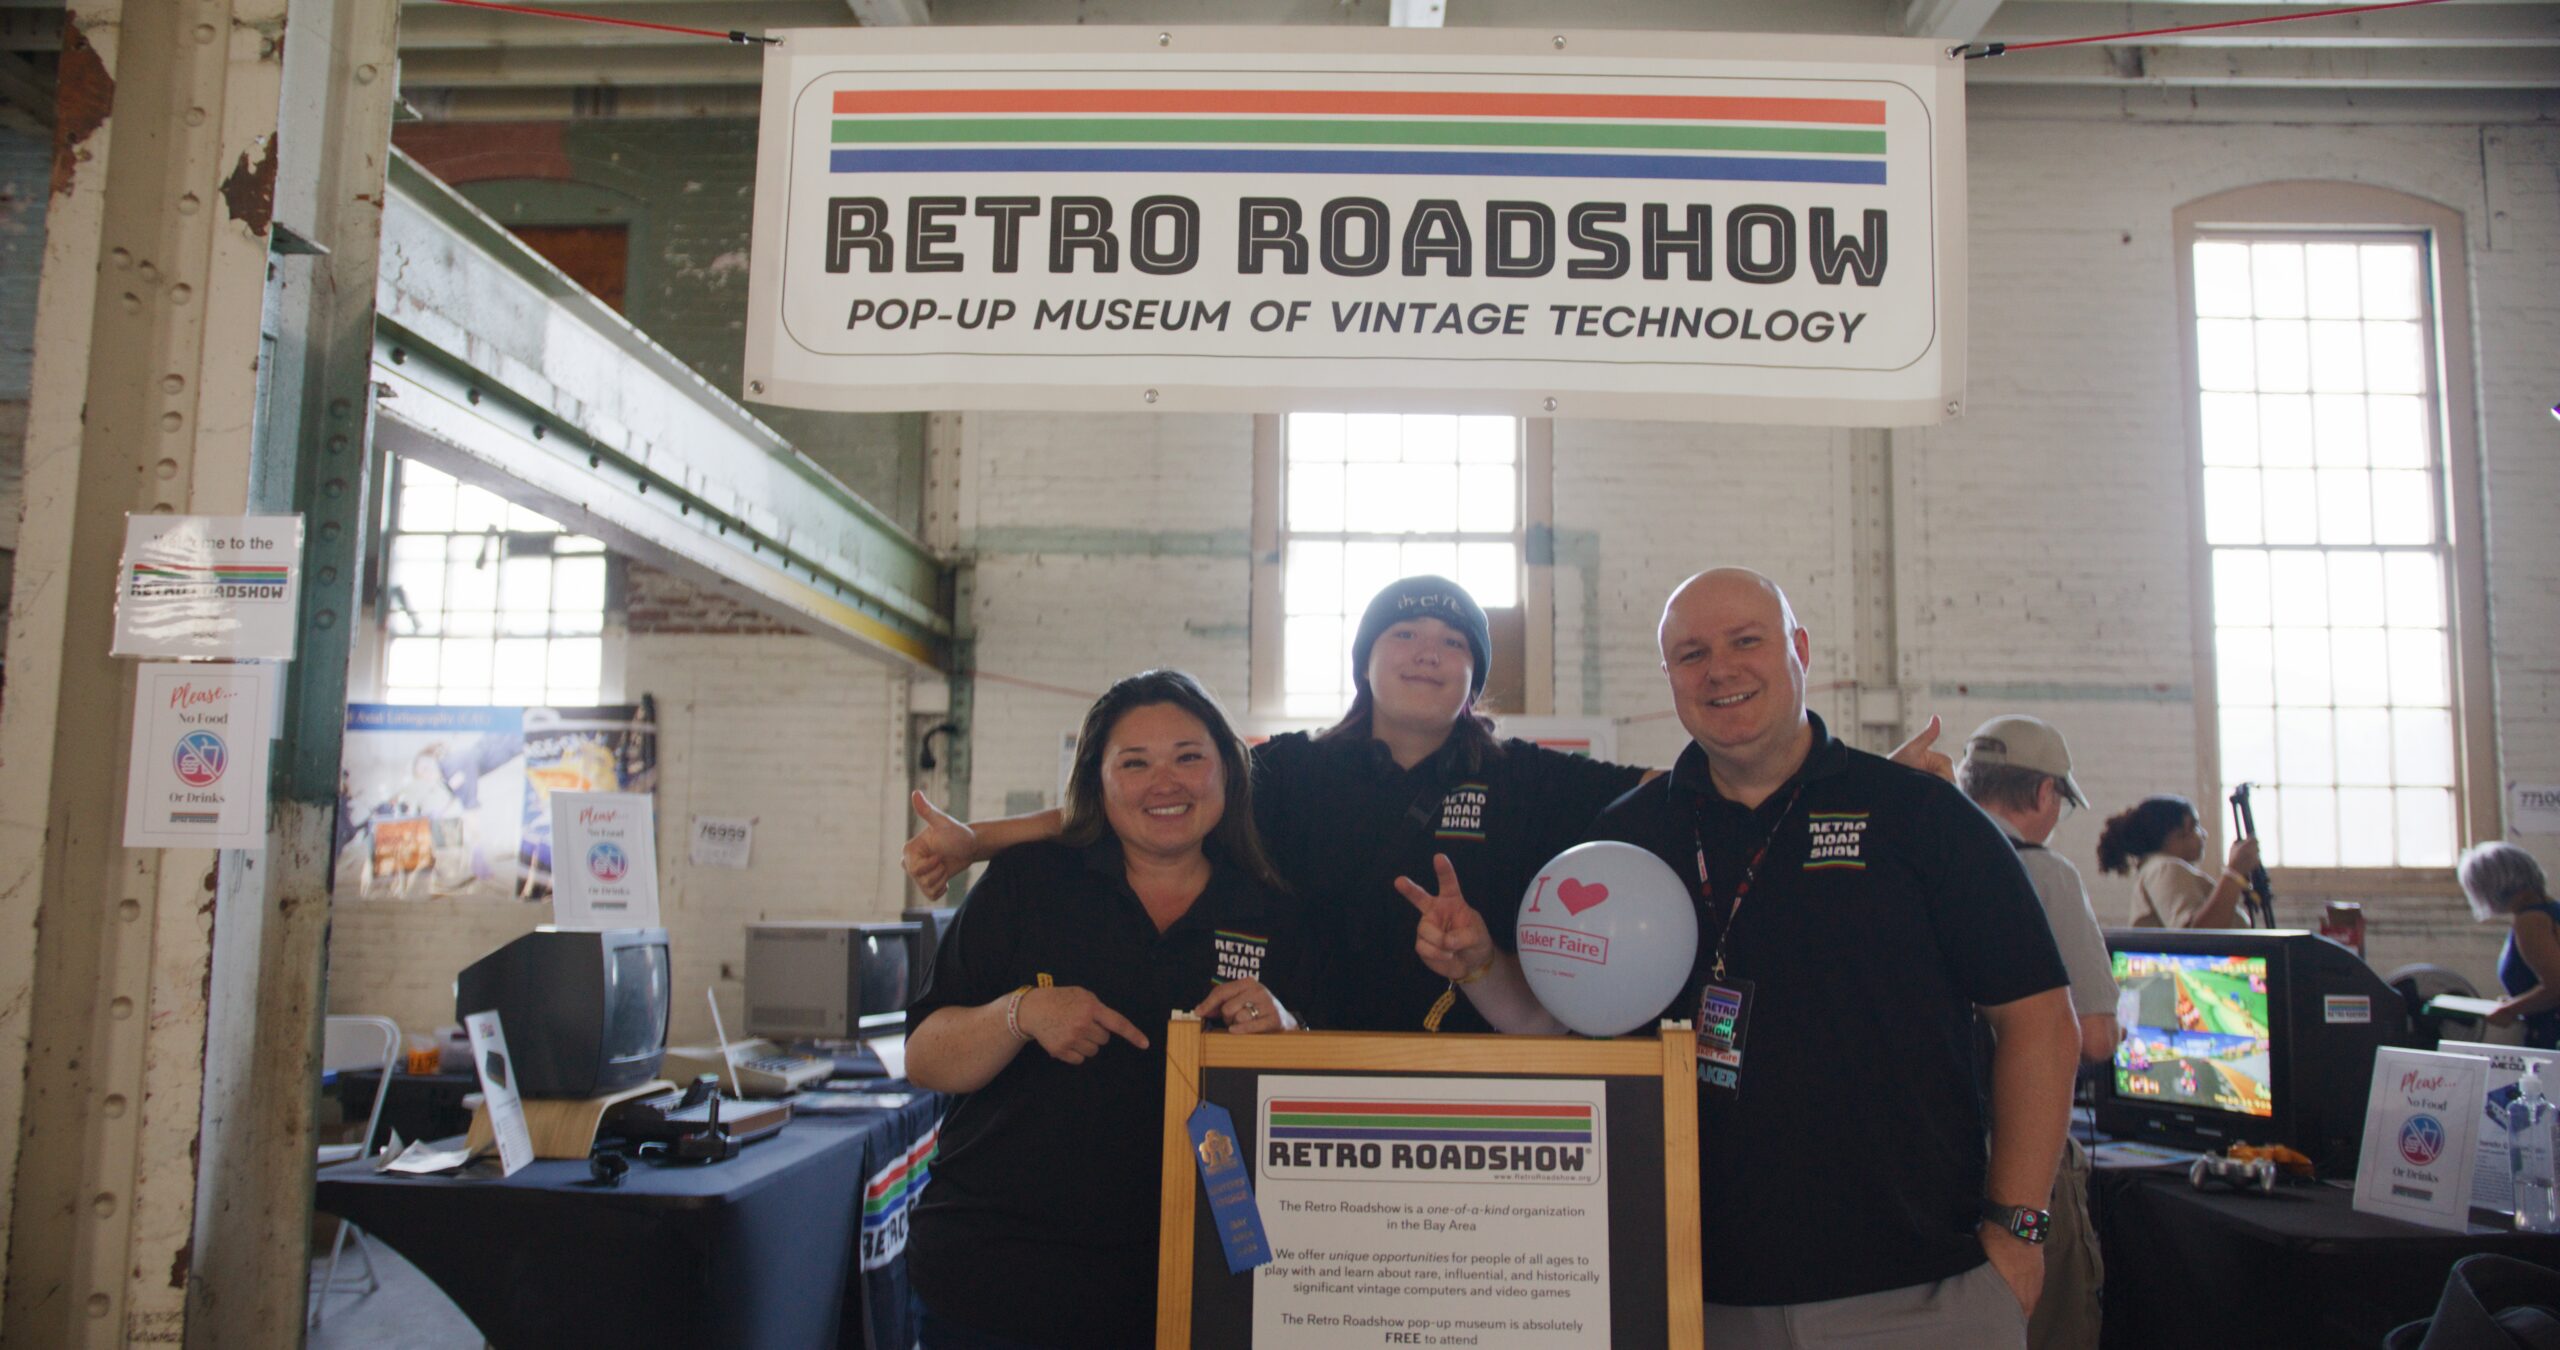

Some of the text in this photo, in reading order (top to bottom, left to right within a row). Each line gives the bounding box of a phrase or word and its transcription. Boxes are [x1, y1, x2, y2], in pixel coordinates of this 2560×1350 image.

[824, 193, 1889, 288] RETRO ROADSHOW
[847, 297, 1867, 345] POP-UP MUSEUM OF VINTAGE TECHNOLOGY
[230, 537, 245, 549] to
[250, 536, 273, 549] the
[198, 712, 229, 725] Food
[187, 792, 226, 804] Drinks
[1444, 804, 1481, 816] ROAD
[1442, 816, 1481, 829] SHOW
[1809, 821, 1867, 833] RETRO
[1813, 832, 1860, 846] ROAD
[1810, 845, 1860, 859] SHOW
[1528, 876, 1551, 913] I
[1215, 939, 1266, 958] RETRO
[1559, 934, 1599, 957] Faire
[1219, 952, 1260, 969] ROAD
[1705, 1000, 1737, 1016] RETRO
[1704, 1012, 1732, 1028] ROAD
[1697, 1062, 1738, 1089] AKER
[2422, 1097, 2448, 1111] Food
[1268, 1141, 1382, 1169] RETRO
[2407, 1168, 2440, 1183] Drinks
[1280, 1200, 1585, 1218] The Retro Roadshow is a one-of-a-kind organization
[1386, 1218, 1477, 1232] in the Bay Area
[1275, 1248, 1590, 1268] We offer unique opportunities for people of all ages to
[1264, 1265, 1600, 1284] play with and learn about rare, influential, and historically
[1293, 1281, 1571, 1300] significant vintage computers and video games
[1281, 1312, 1583, 1333] The Retro Roadshow pop-up museum is absolutely
[1385, 1332, 1478, 1346] FREE to attend
